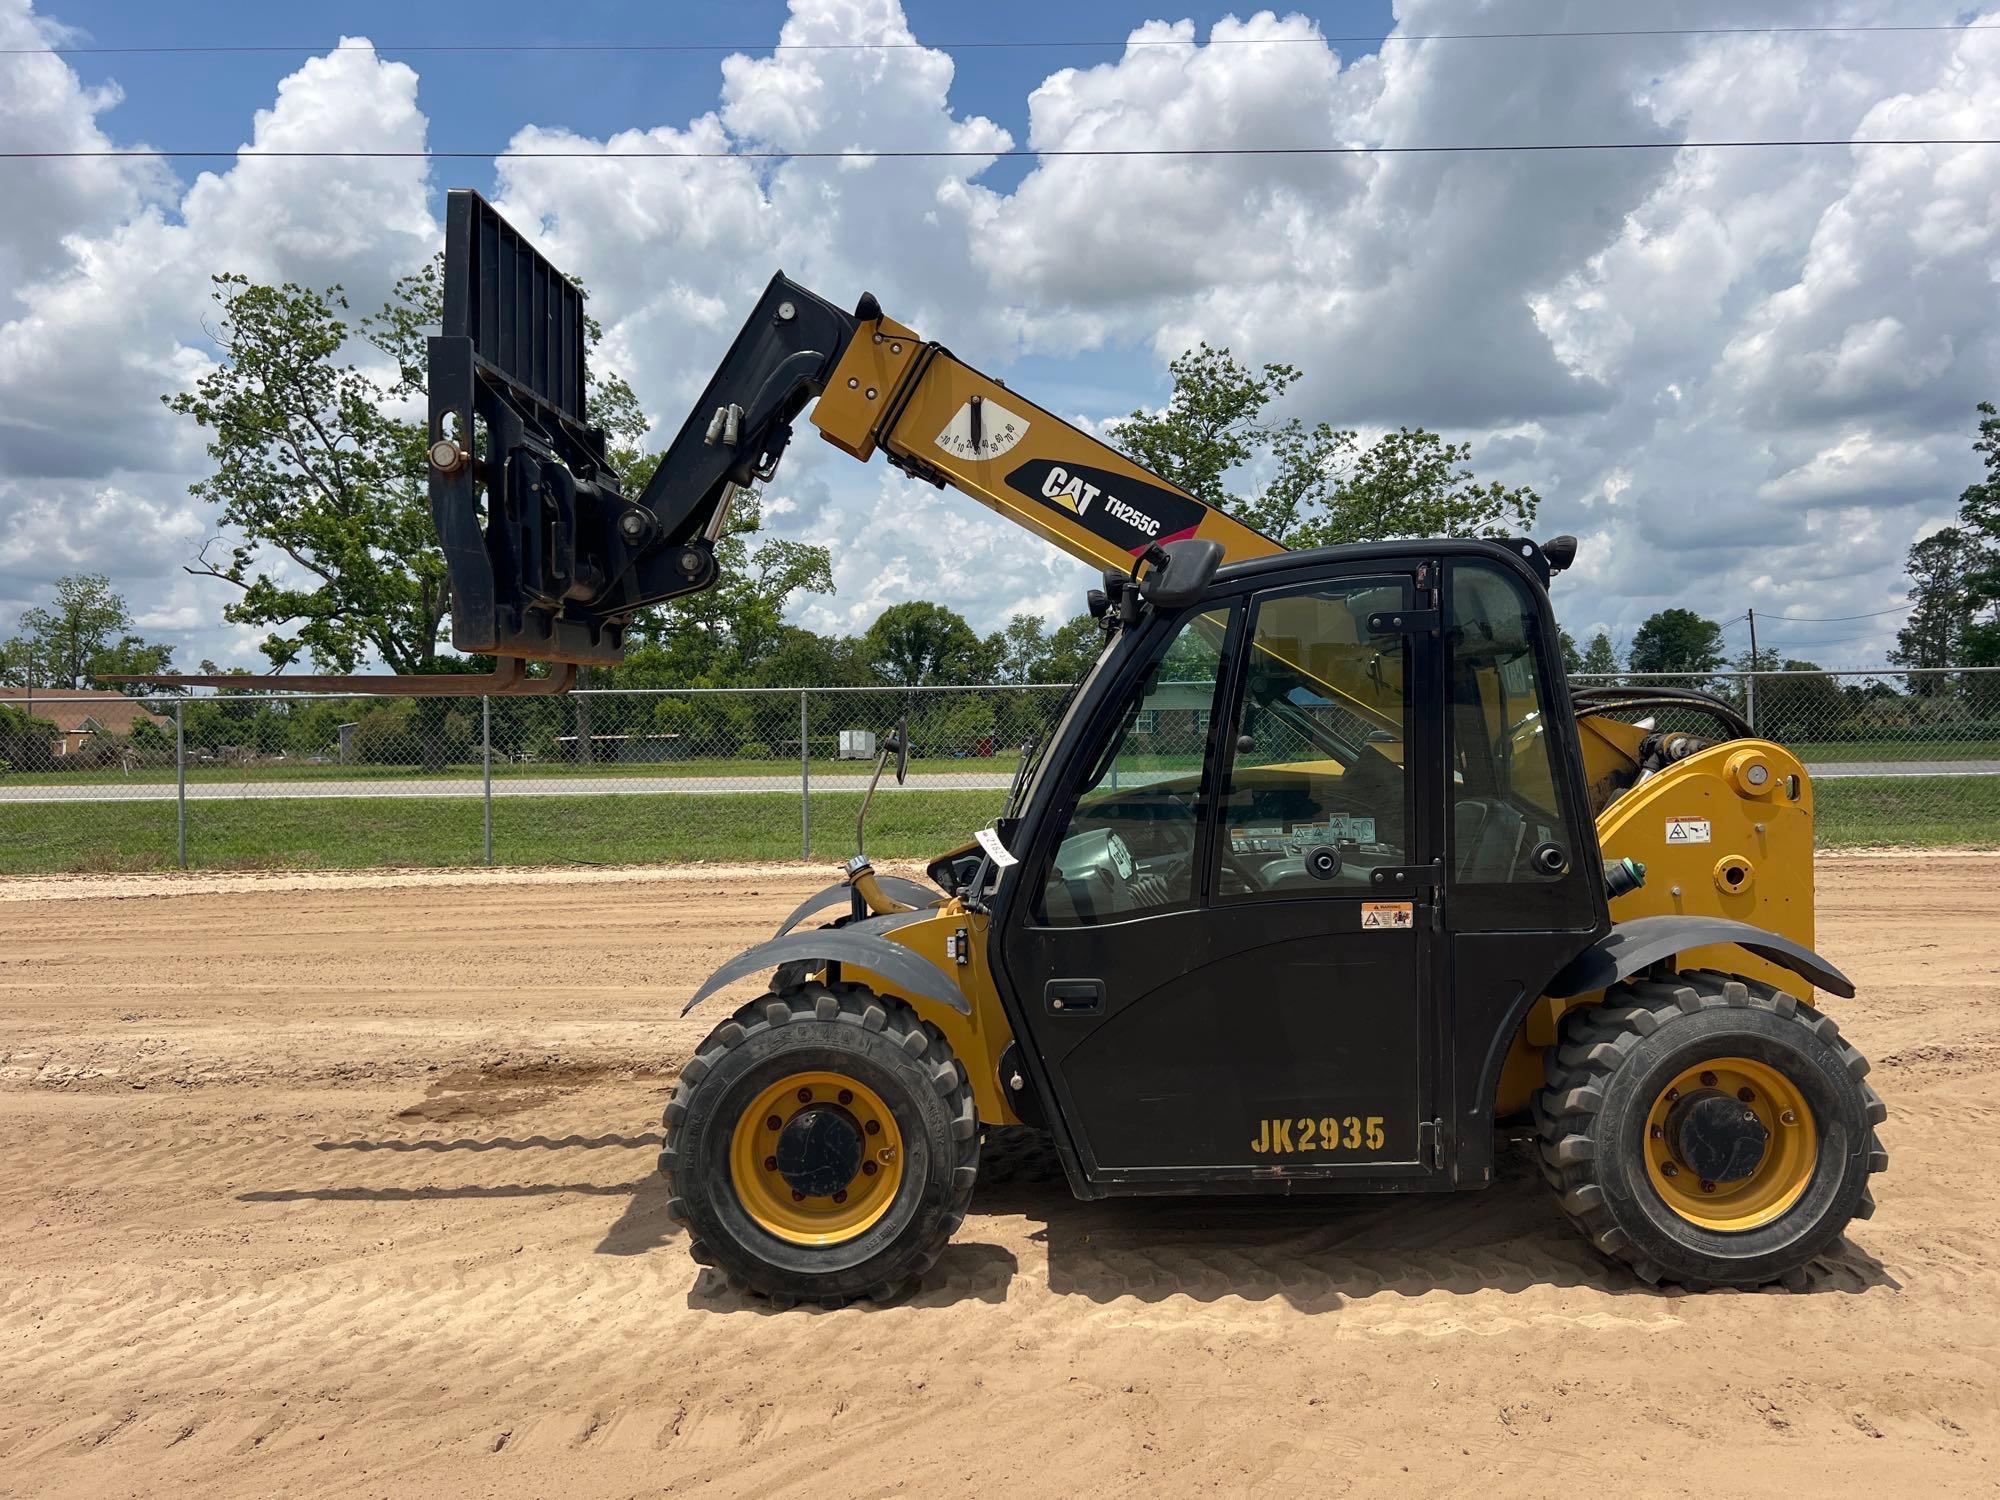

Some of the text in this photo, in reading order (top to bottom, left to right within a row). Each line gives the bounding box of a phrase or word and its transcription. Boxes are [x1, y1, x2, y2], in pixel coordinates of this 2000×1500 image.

[1005, 423, 1015, 433] 80
[940, 435, 950, 445] -10
[953, 435, 960, 444] 0
[994, 433, 1004, 444] 60
[1004, 433, 1014, 443] 70
[957, 443, 965, 453] 10
[966, 439, 973, 449] 20
[981, 439, 989, 449] 40
[990, 442, 999, 453] 50
[1041, 466, 1161, 537] CAT TH255C
[1250, 1116, 1385, 1154] JK2935
